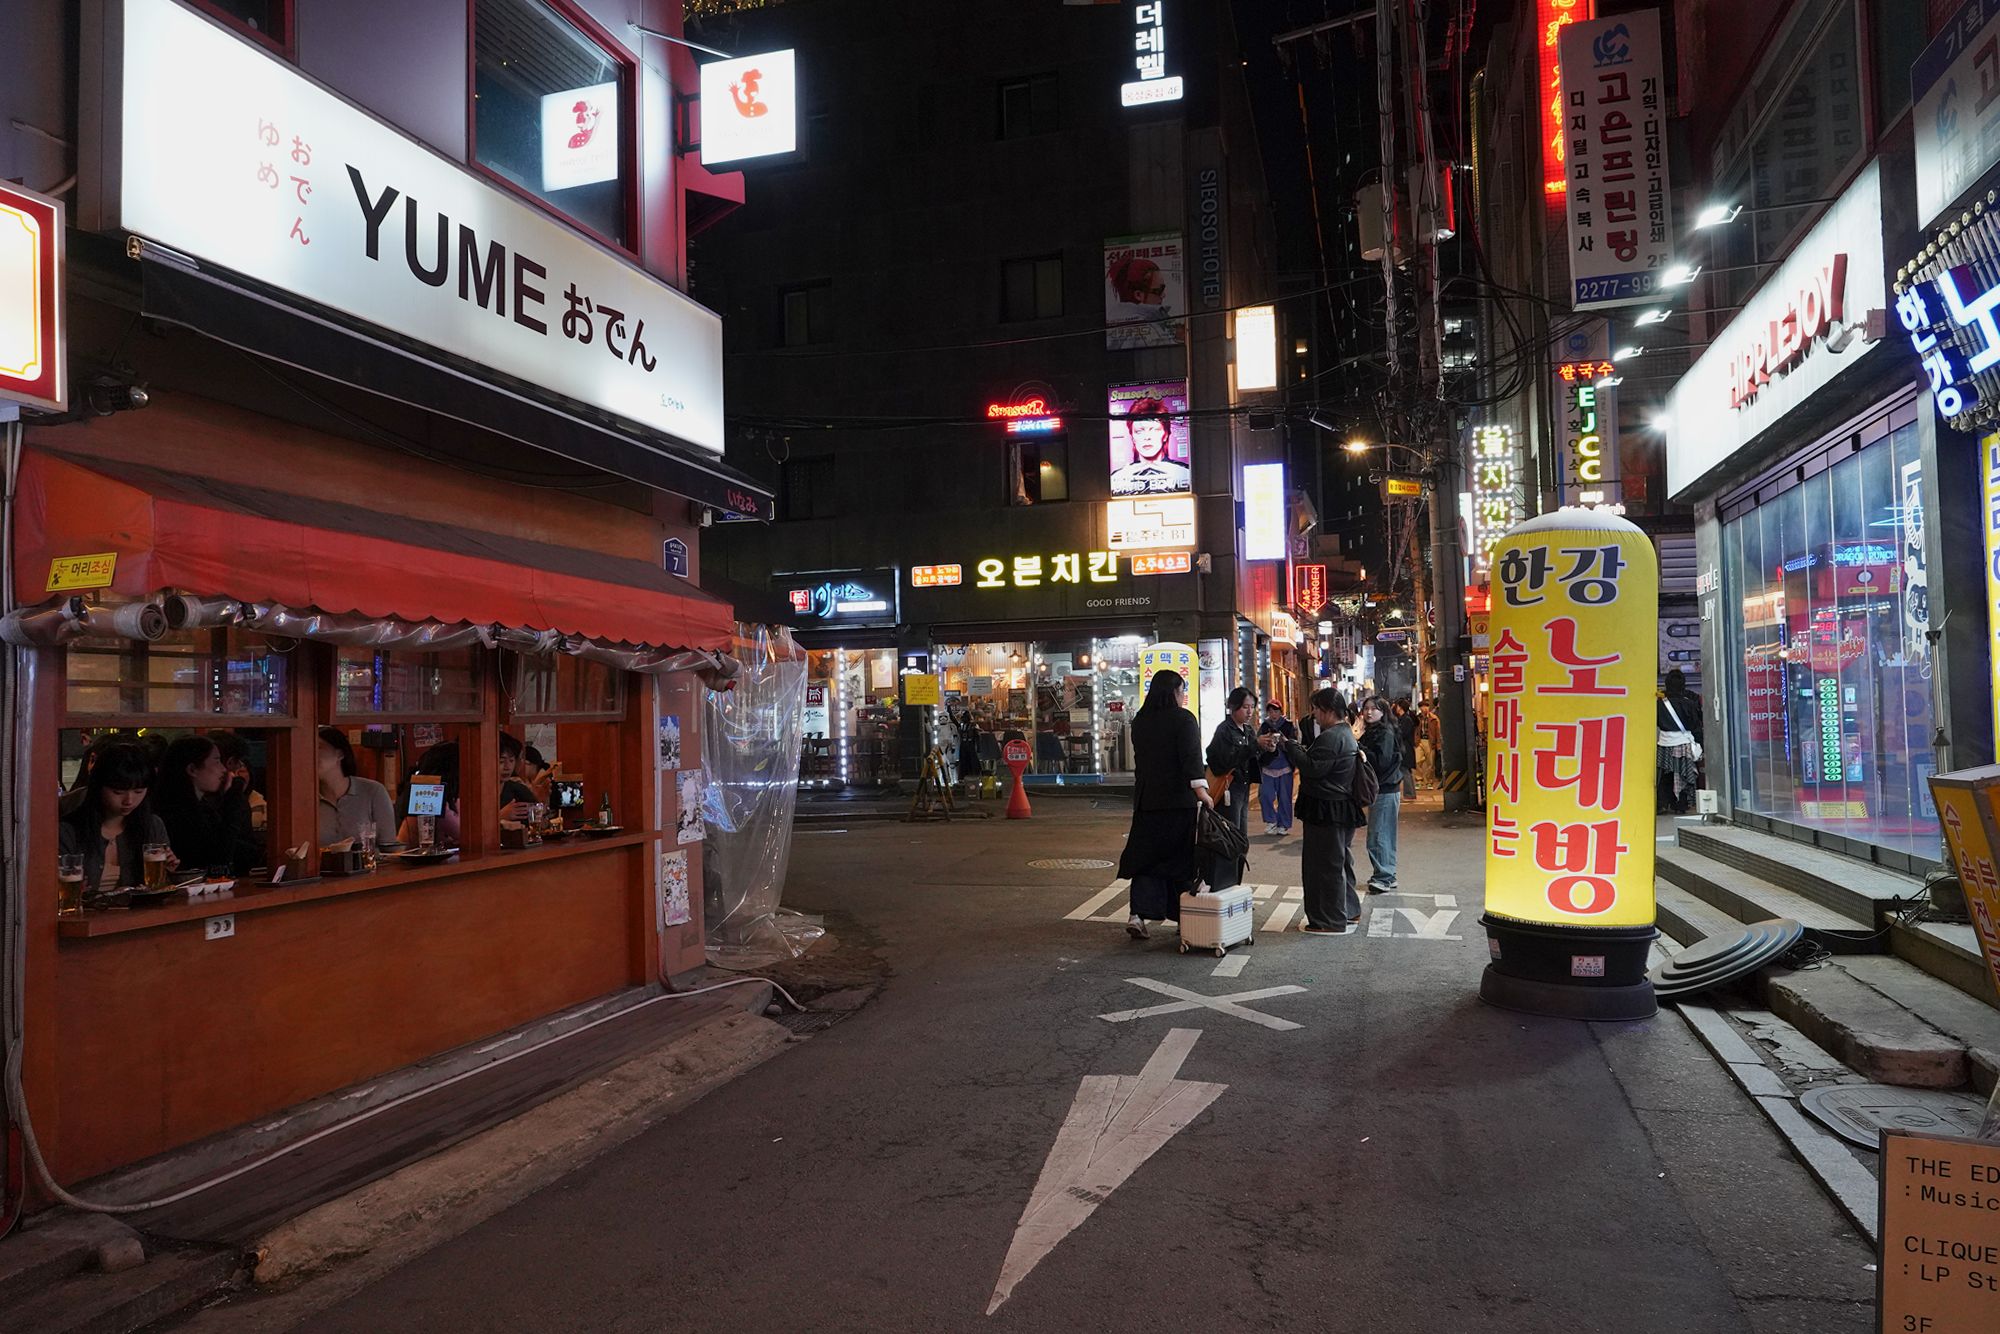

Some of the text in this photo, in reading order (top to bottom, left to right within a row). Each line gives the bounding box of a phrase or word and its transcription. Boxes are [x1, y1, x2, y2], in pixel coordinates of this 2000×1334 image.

[1136, 1, 1165, 79] 더레벨
[257, 117, 280, 189] ゆめ
[1570, 91, 1594, 253] 디지털고속복사
[1598, 71, 1638, 263] 고은프린팅
[290, 135, 312, 246] おでん
[1200, 170, 1220, 306] SIEOSO HOTEL
[345, 163, 657, 373] YUME おでん
[1558, 361, 1615, 380] 쌀국수
[1896, 285, 1963, 418] 한강
[71, 560, 112, 576] 머리조심
[673, 557, 679, 571] 7
[977, 552, 1119, 587] 오븐치킨
[1135, 556, 1188, 571] 소주&호프
[1500, 547, 1625, 606] 한강
[1086, 597, 1151, 608] GOOD FRIENDS
[1144, 652, 1190, 665] 생맥주
[1492, 629, 1529, 856] 술마시는
[1529, 617, 1628, 915] 노래방
[1906, 1156, 1951, 1178] THE
[1904, 1236, 1999, 1264] CLIQUE
[1968, 1271, 1998, 1292] St
[1903, 1315, 1933, 1334] 3F
